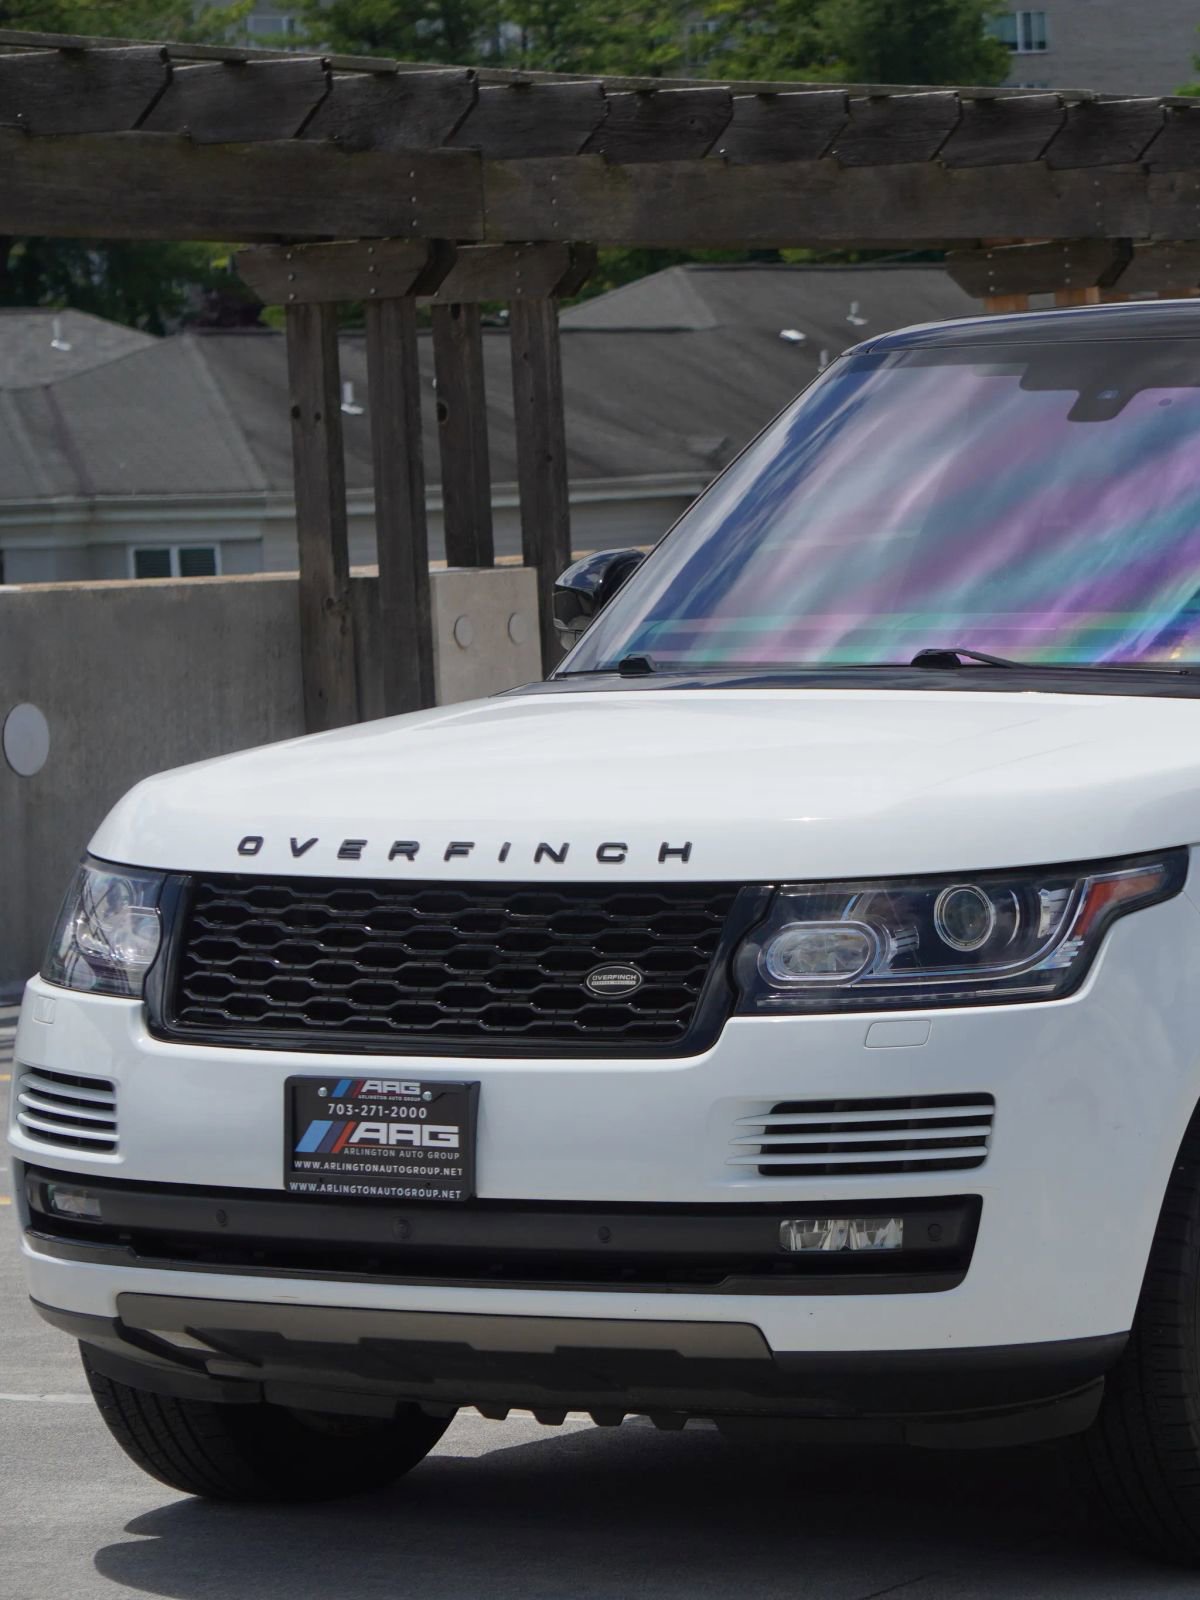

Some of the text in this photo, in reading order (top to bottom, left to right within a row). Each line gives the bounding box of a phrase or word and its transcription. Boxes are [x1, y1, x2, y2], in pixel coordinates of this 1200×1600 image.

[237, 835, 693, 863] OVERFINCH
[360, 1080, 421, 1095] AAG
[327, 1103, 427, 1119] 703-271-2000
[348, 1121, 460, 1148] AAG
[343, 1147, 460, 1160] ARLINGTON AUTO GROUP
[294, 1160, 463, 1176] WWW.ARLINGTONAUTOGROUP.NET
[289, 1181, 462, 1199] WWW.ARLINGTONAUTOGROUP.NET
